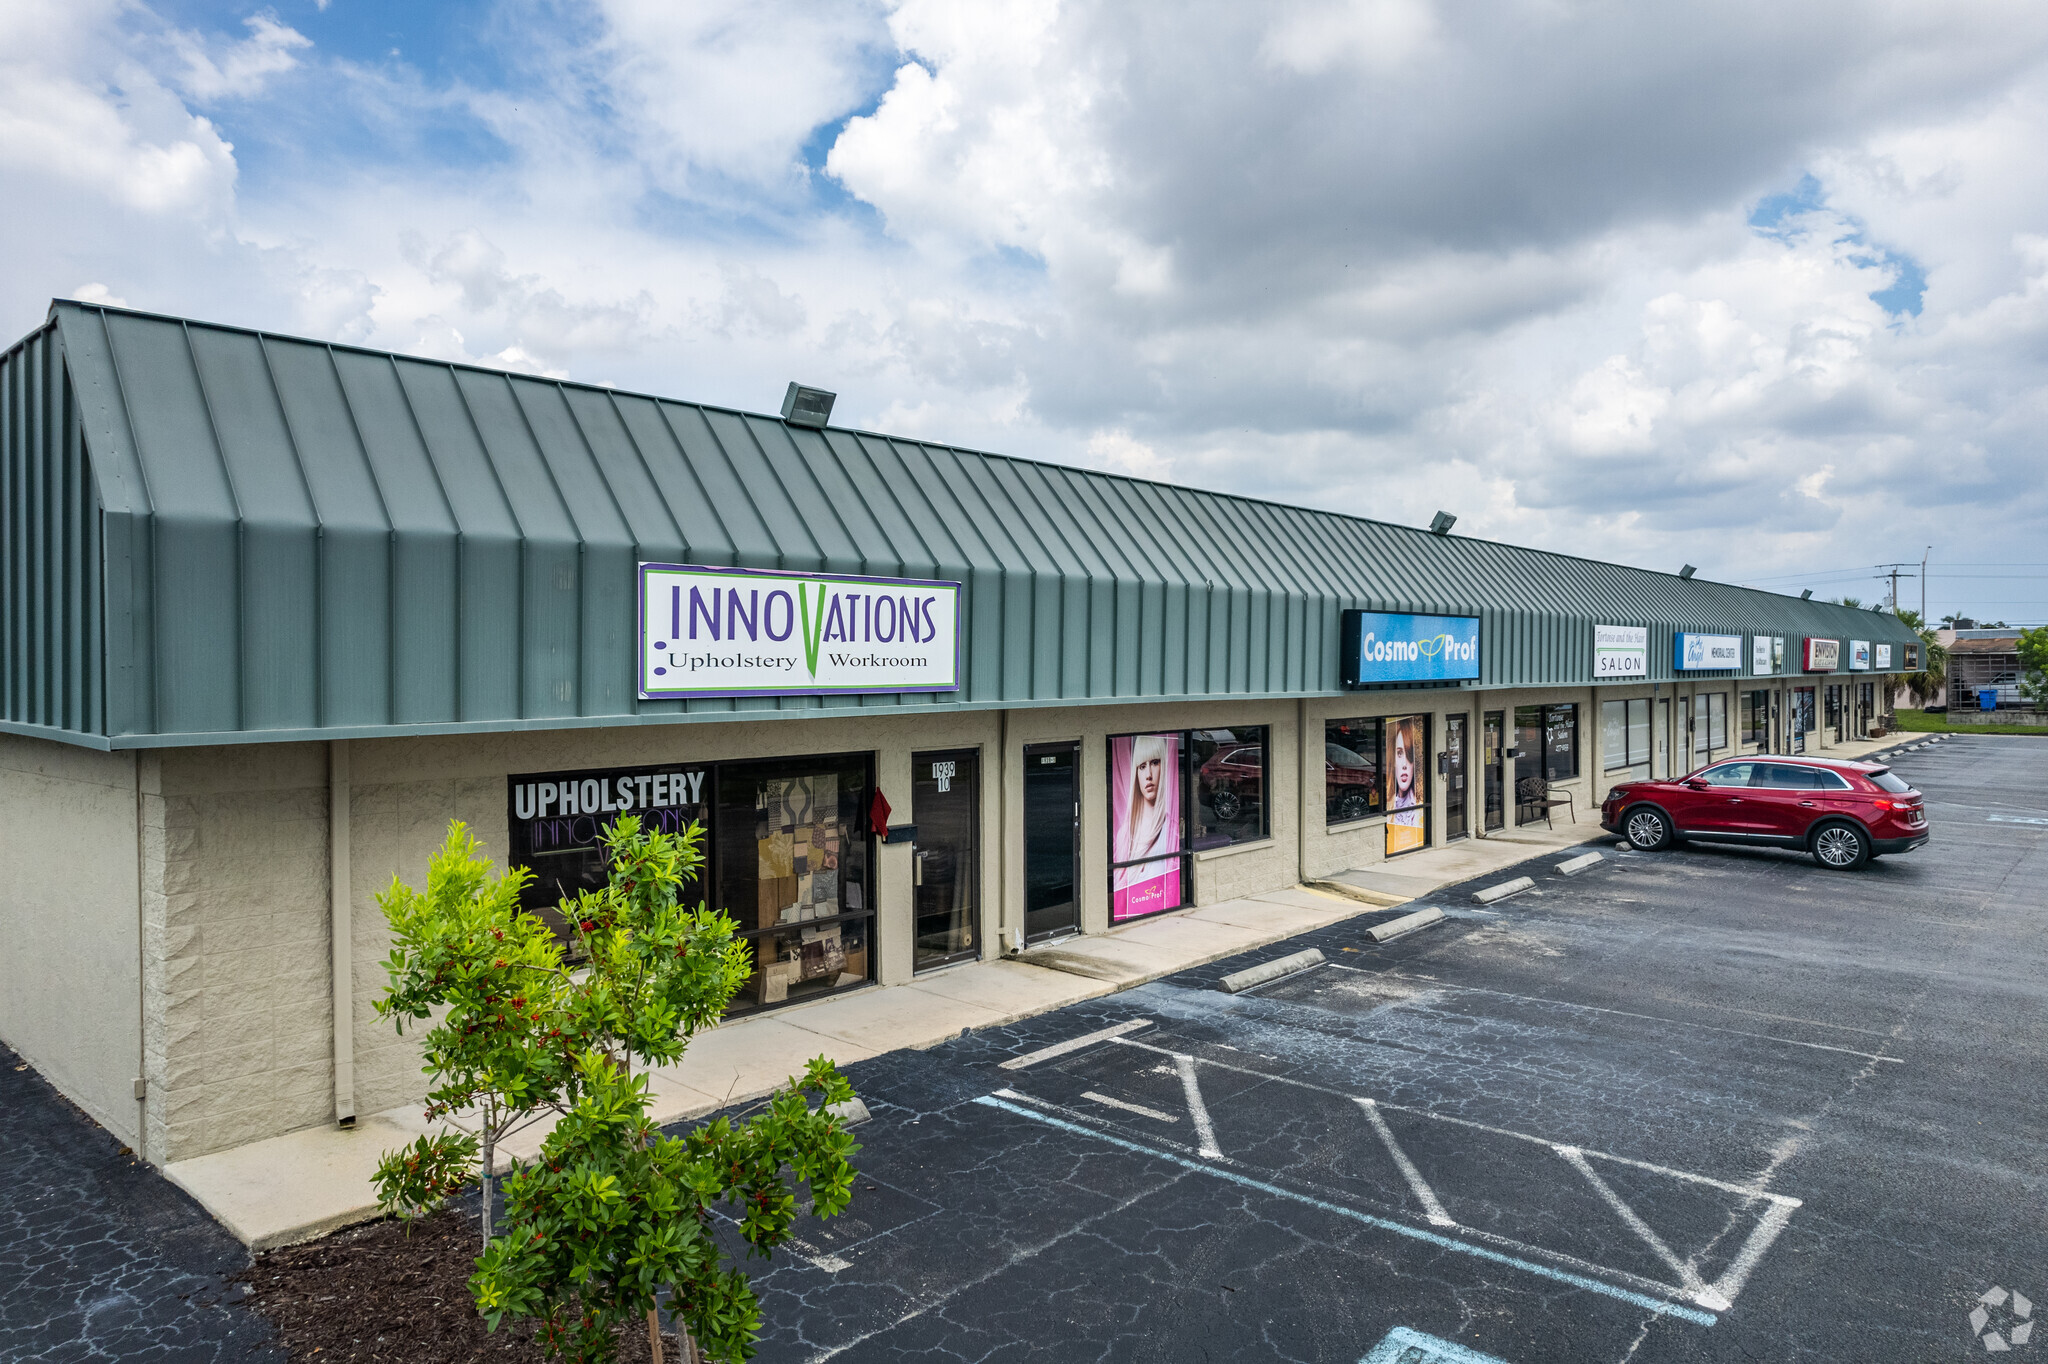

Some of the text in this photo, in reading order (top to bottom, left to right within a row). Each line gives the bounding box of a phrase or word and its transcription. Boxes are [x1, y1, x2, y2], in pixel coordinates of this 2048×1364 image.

[672, 582, 936, 679] INNOVATIONS
[1616, 631, 1625, 642] and
[1364, 632, 1476, 661] Cosmo Prof
[1815, 643, 1837, 658] ENVISION
[668, 652, 928, 671] Upholstery Workroom
[1601, 657, 1641, 671] SALON
[933, 762, 955, 778] 1939
[939, 777, 950, 791] 10
[515, 771, 705, 820] UPHOLSTERY
[535, 806, 692, 866] INNOVIONS
[1131, 890, 1163, 904] Cosmo Prof
